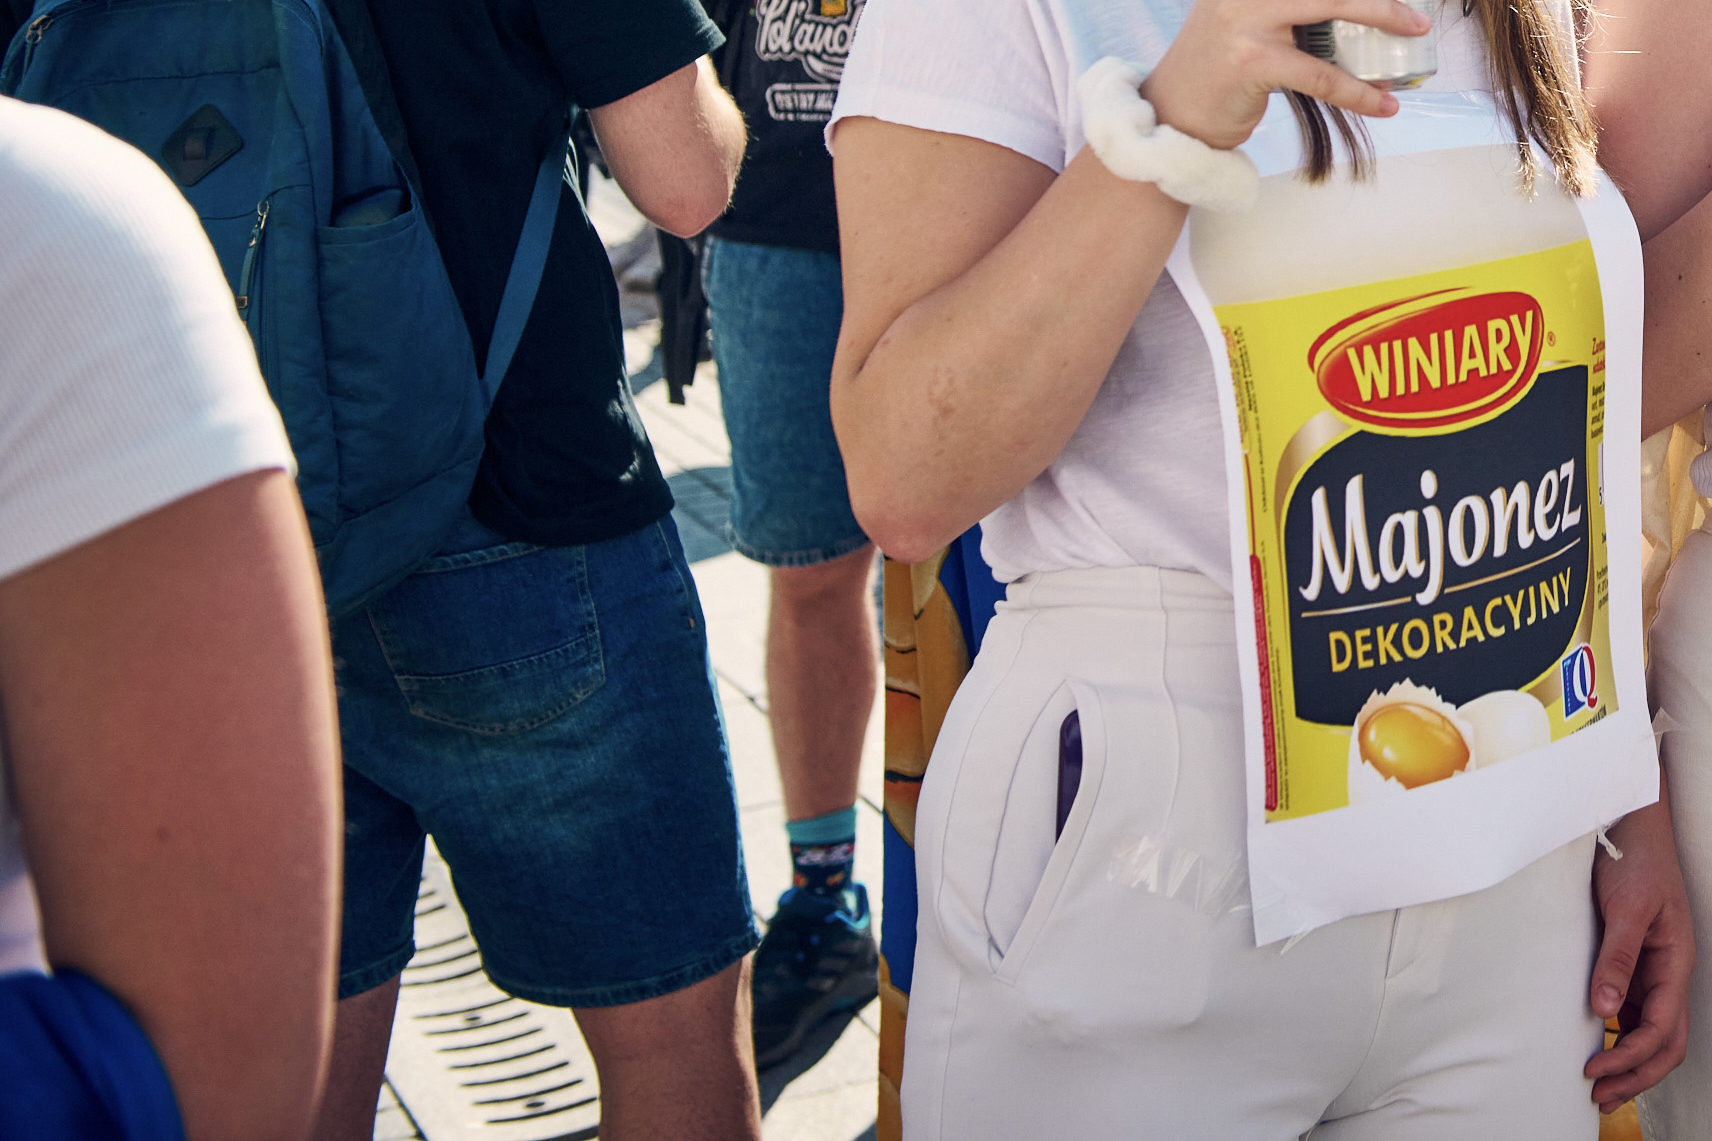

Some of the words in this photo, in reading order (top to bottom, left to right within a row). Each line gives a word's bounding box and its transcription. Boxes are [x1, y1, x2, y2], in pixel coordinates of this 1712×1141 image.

[1346, 309, 1534, 403] WINIARY
[1299, 458, 1582, 606] Majonez
[1328, 566, 1572, 673] DEKORACYJNY
